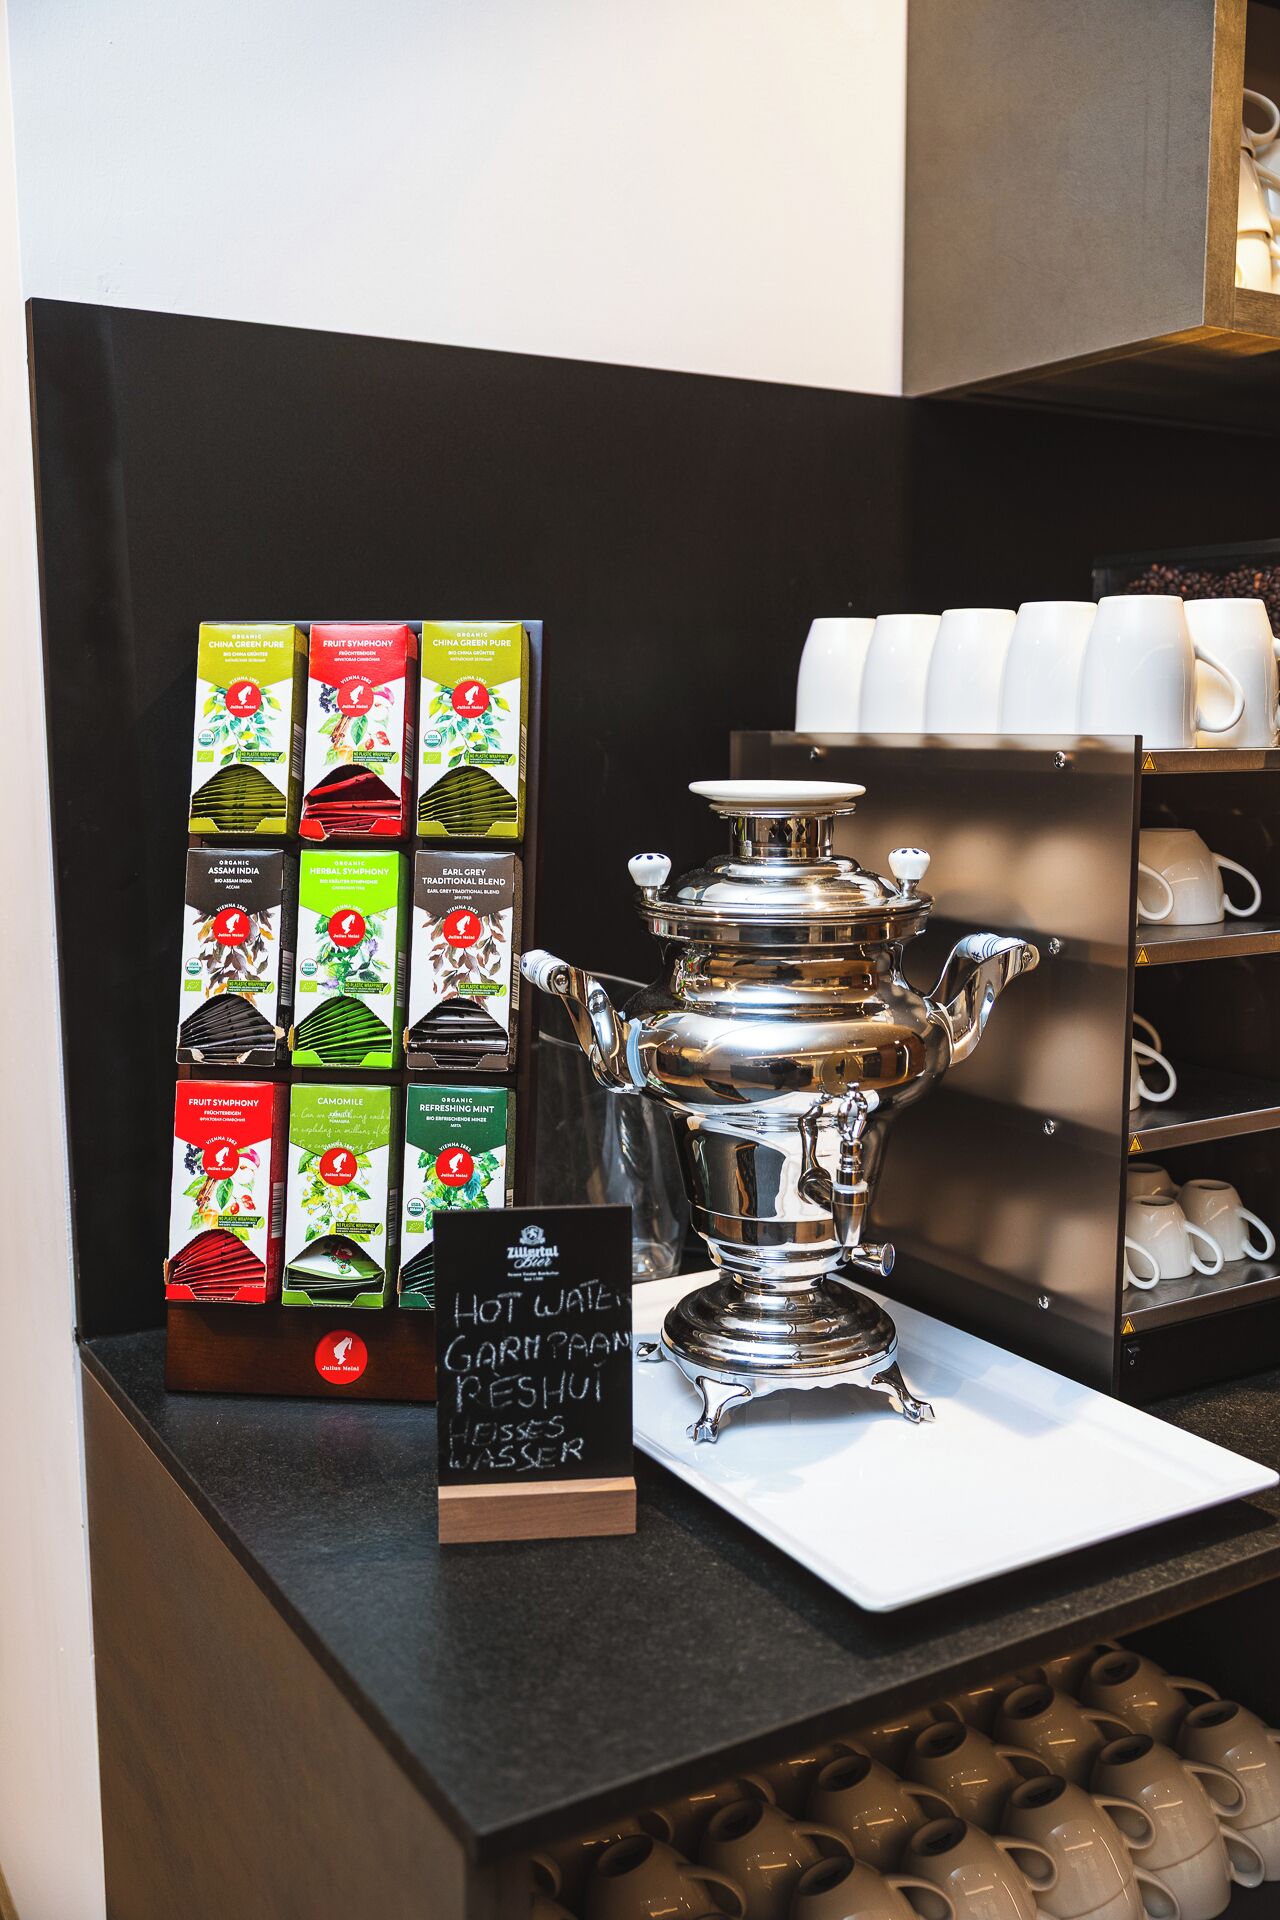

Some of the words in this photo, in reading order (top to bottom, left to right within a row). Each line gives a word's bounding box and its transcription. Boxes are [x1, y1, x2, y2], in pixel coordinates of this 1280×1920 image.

[420, 1104, 471, 1112] REFRESHING
[507, 1245, 559, 1258] Zillertal
[514, 1256, 552, 1269] Bier
[454, 1292, 524, 1328] HOT
[450, 1415, 565, 1445] HEISSES
[449, 1438, 583, 1472] WASSER
